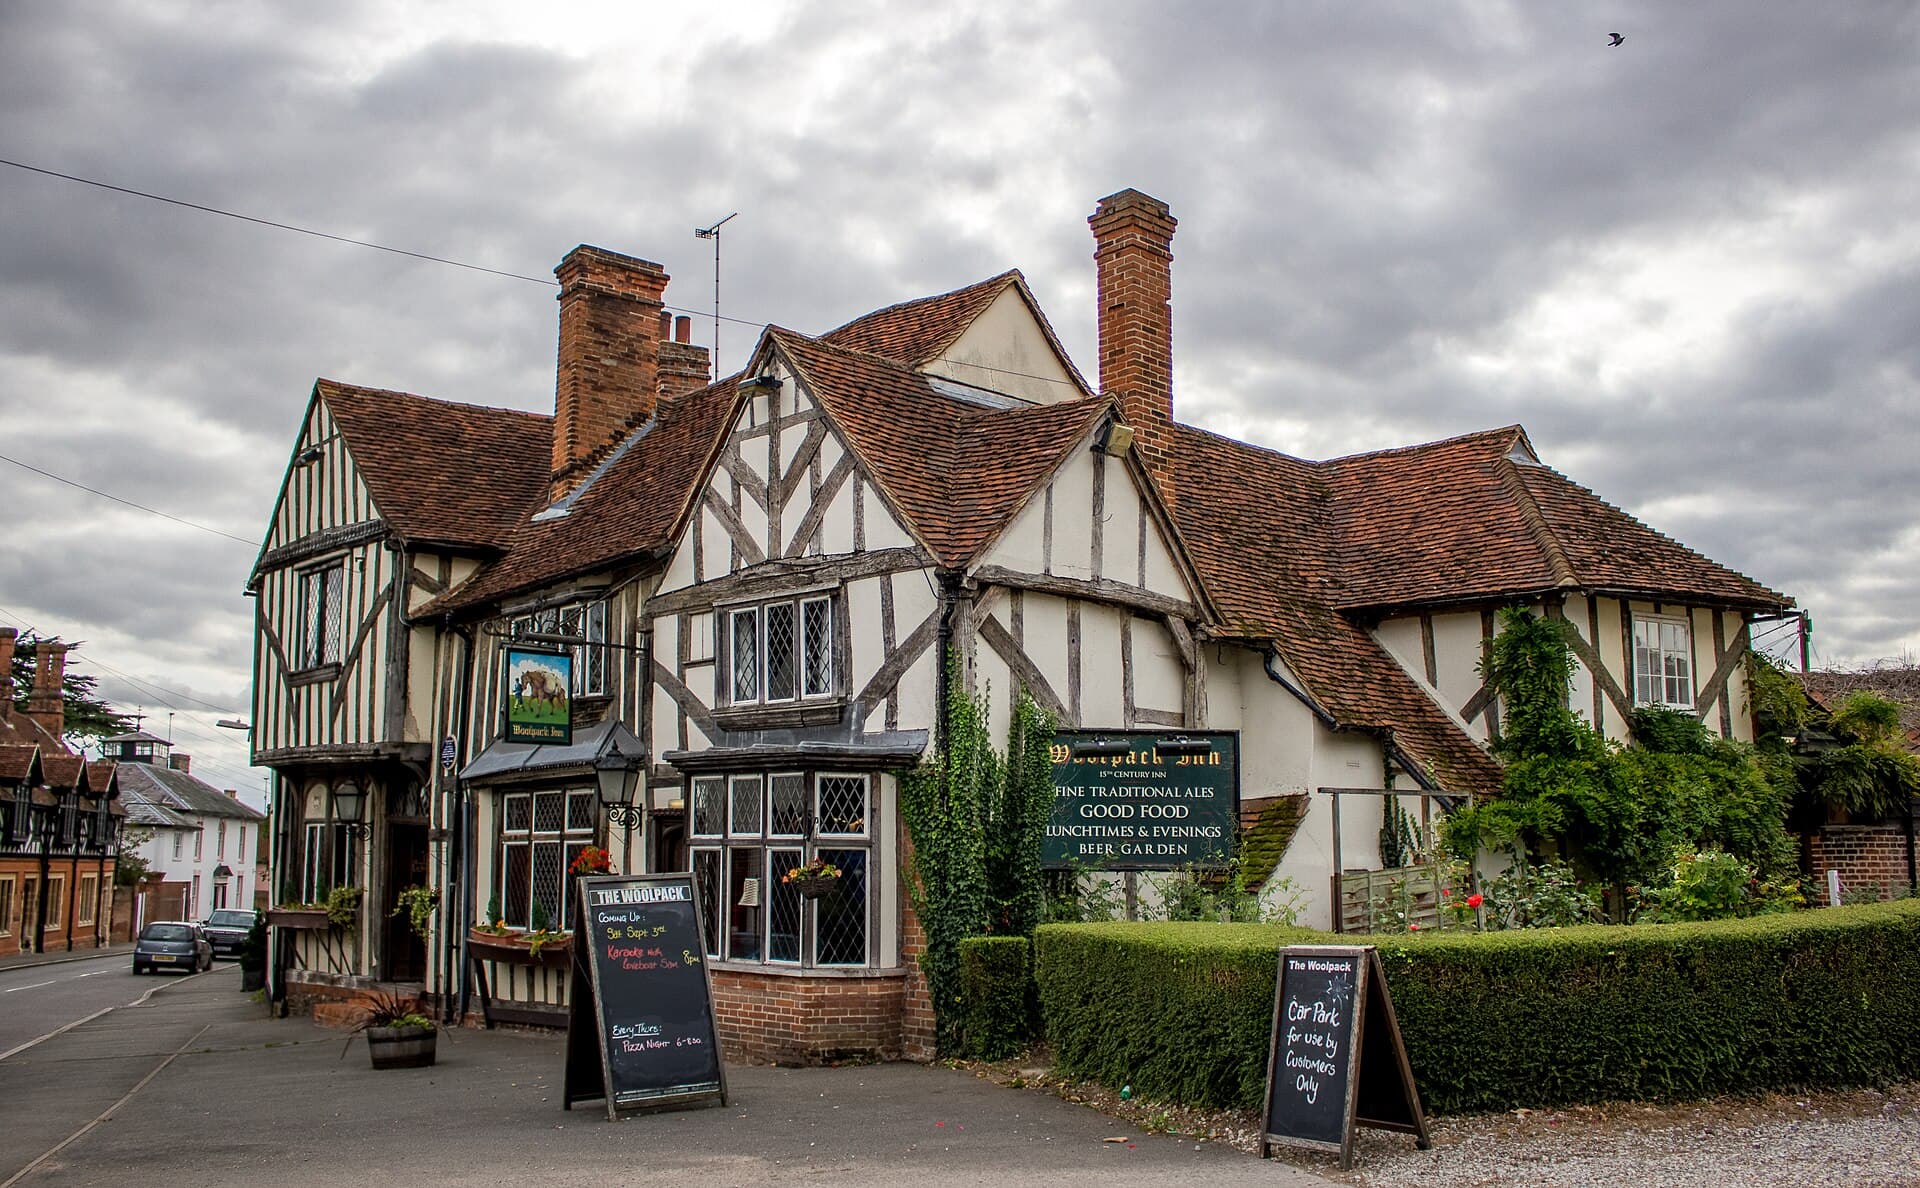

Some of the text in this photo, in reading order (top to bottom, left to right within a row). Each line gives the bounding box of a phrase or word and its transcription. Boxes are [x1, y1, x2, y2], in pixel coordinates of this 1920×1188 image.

[1113, 770, 1150, 778] CENTURY
[1055, 786, 1215, 798] FINE TRADITIONAL ALES
[1080, 804, 1189, 819] GOOD FOOD
[1046, 825, 1222, 838] LUNCHTIMES & EVENINGS
[1079, 843, 1188, 855] BEER GARDEN
[597, 886, 685, 904] THE WOOLPACK
[1289, 960, 1352, 974] The Woolpack
[1288, 1000, 1340, 1028] Car Park
[1287, 1025, 1339, 1059] for use by
[1286, 1049, 1336, 1077] Customers
[1296, 1073, 1320, 1105] Only
